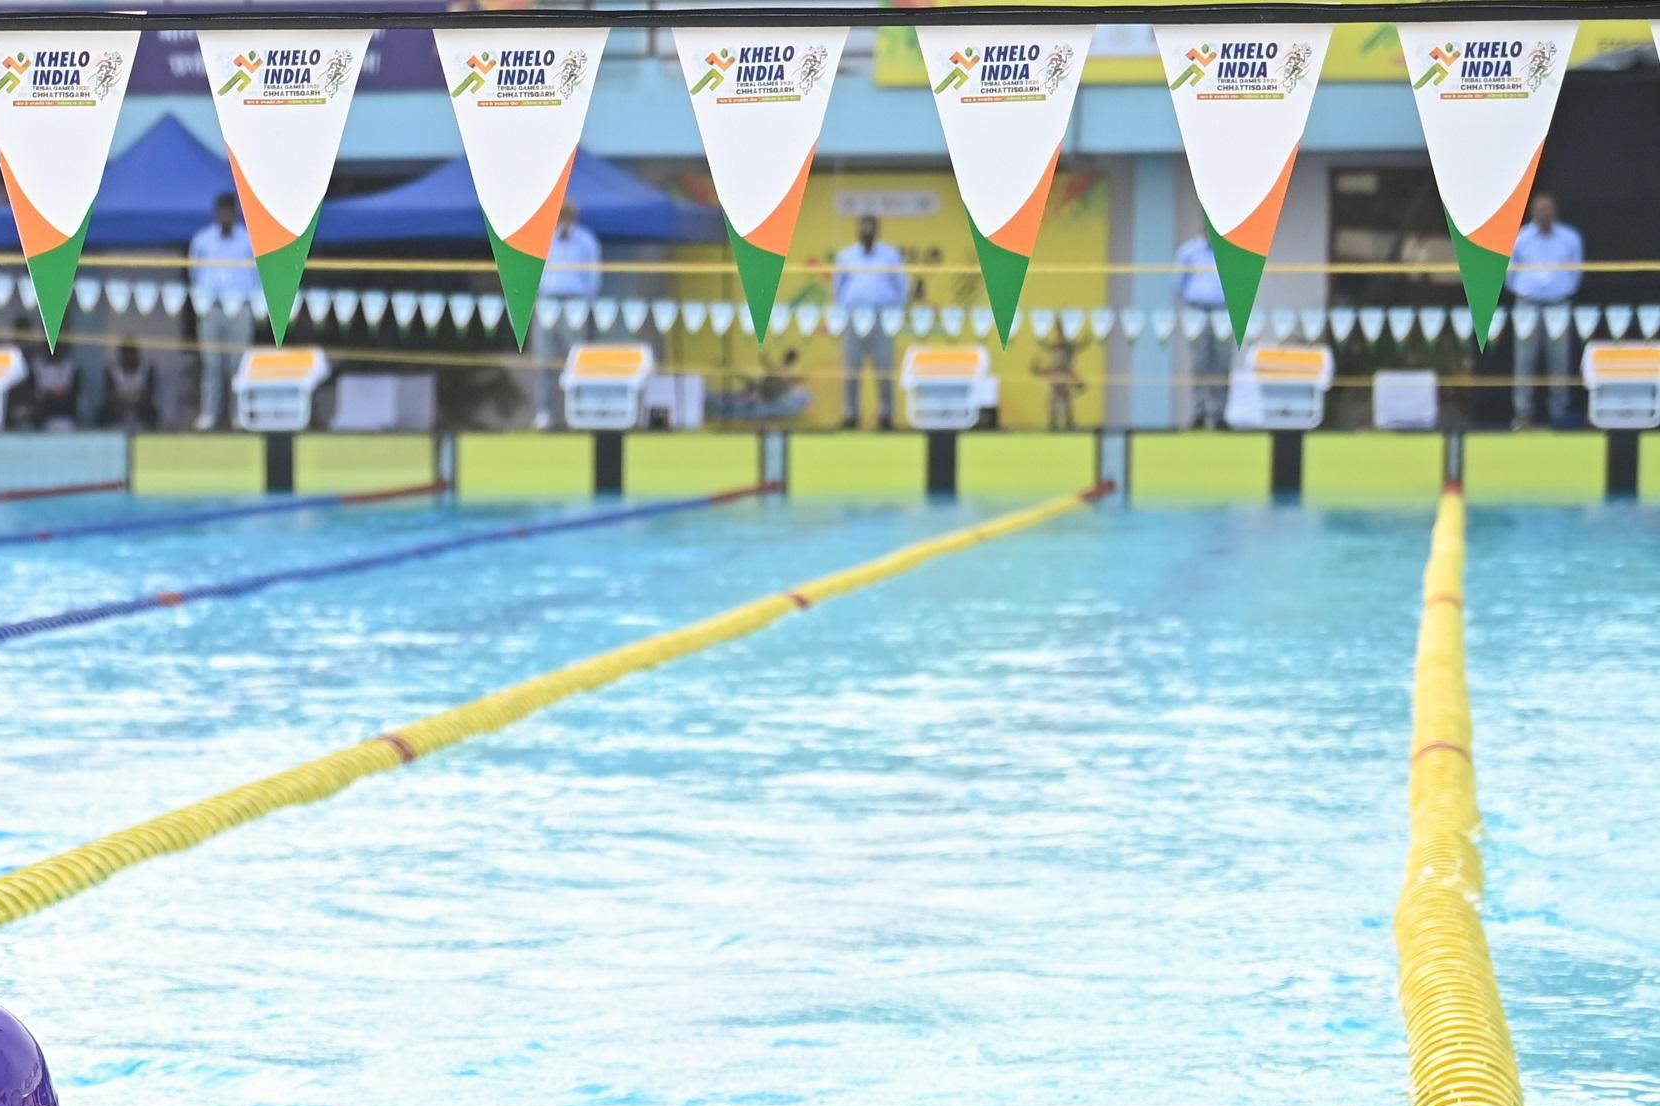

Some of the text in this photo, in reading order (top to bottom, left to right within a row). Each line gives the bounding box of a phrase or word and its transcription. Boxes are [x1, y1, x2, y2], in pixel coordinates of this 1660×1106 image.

[267, 49, 321, 66] KHELO
[739, 46, 794, 63] KHELO
[983, 45, 1040, 62] KHELO
[1220, 42, 1278, 60] KHELO
[1464, 41, 1522, 58] KHELO
[35, 51, 90, 68] KHELO
[500, 50, 555, 67] KHELO
[264, 68, 311, 84] INDIA
[497, 69, 545, 85] INDIA
[736, 65, 784, 81] INDIA
[980, 64, 1030, 81] INDIA
[1217, 61, 1267, 78] INDIA
[1461, 60, 1512, 77] INDIA
[32, 69, 80, 86] INDIA
[32, 91, 90, 99] CHHATTISGARH
[735, 87, 795, 95] CHHATTISGARH
[980, 86, 1040, 94] CHHATTISGARH
[1217, 84, 1278, 92] CHHATTISGARH
[1460, 83, 1522, 91] CHHATTISGARH
